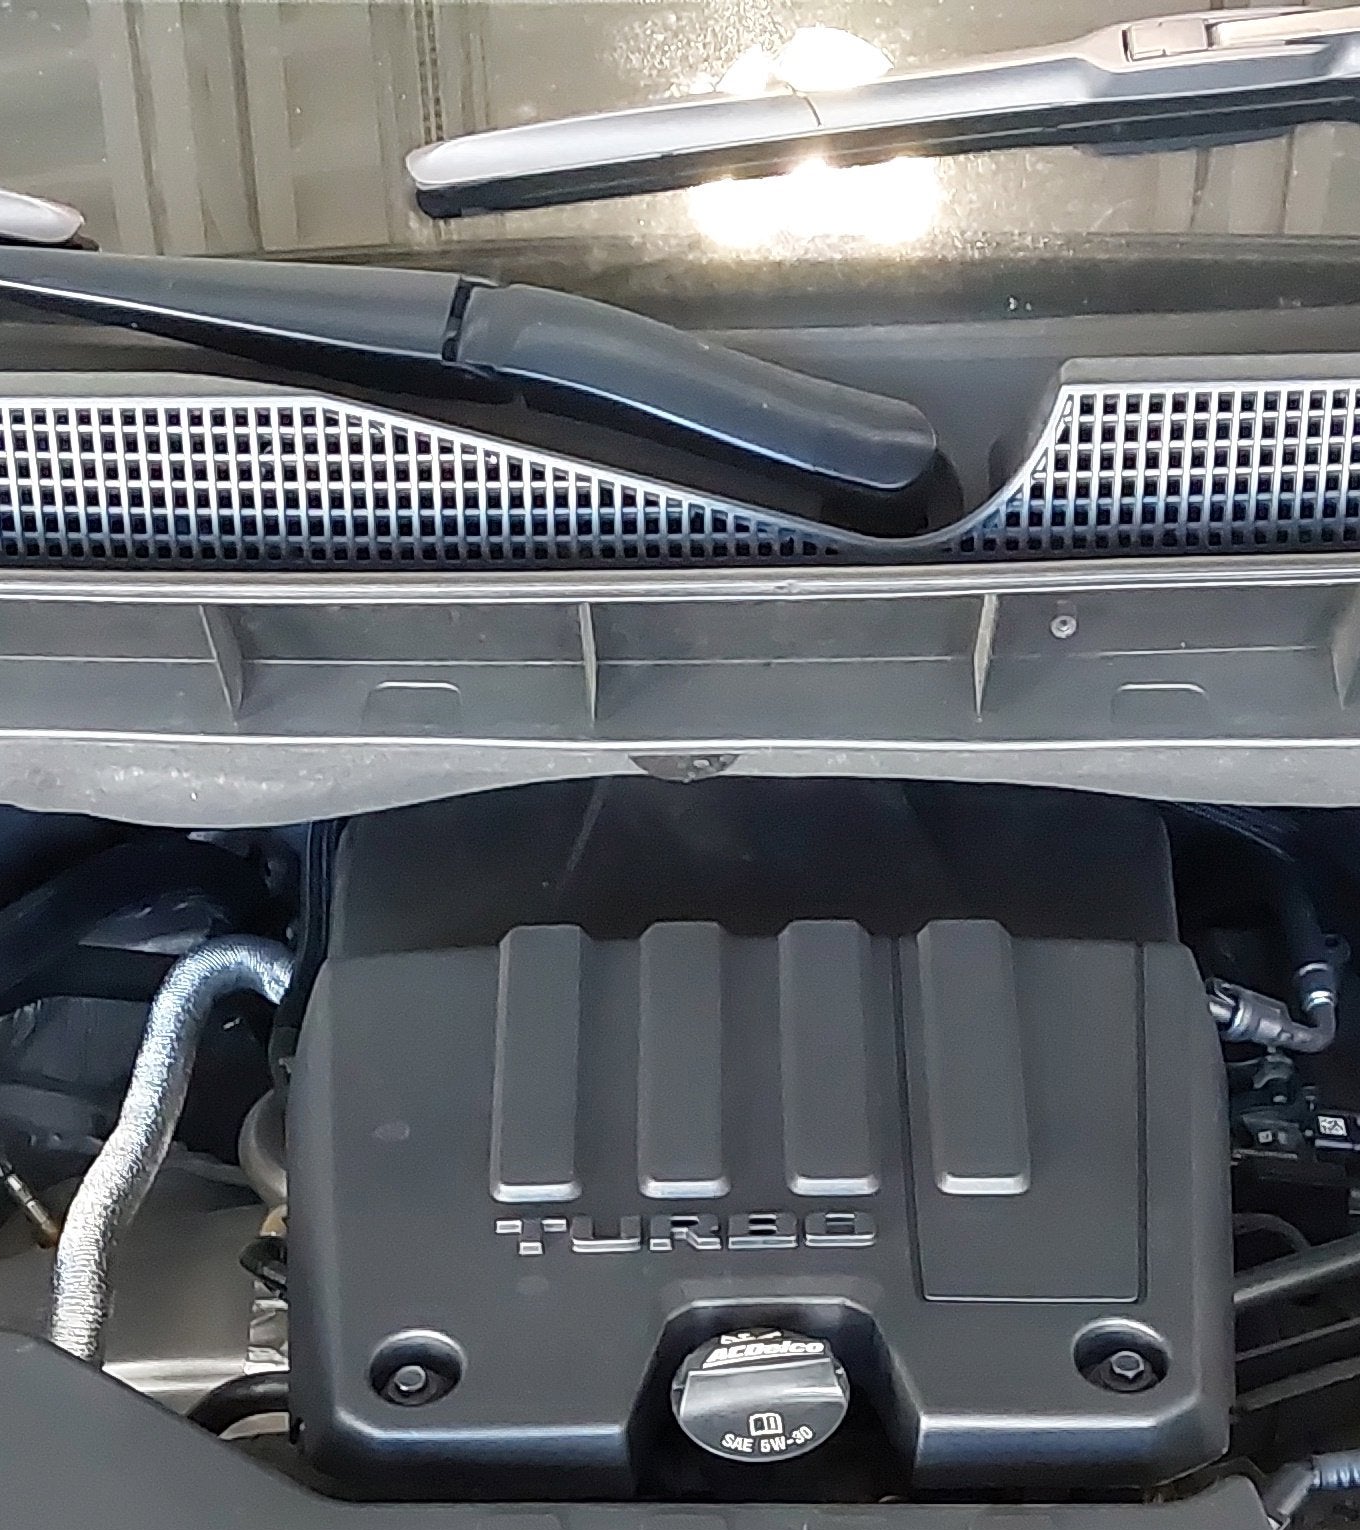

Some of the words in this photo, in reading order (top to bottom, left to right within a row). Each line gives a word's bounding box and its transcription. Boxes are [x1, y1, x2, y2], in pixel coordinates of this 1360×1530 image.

[495, 1213, 876, 1255] TURBO
[706, 1340, 825, 1363] ACDelco
[722, 1433, 754, 1453] SAE
[760, 1425, 814, 1453] 5W-30
